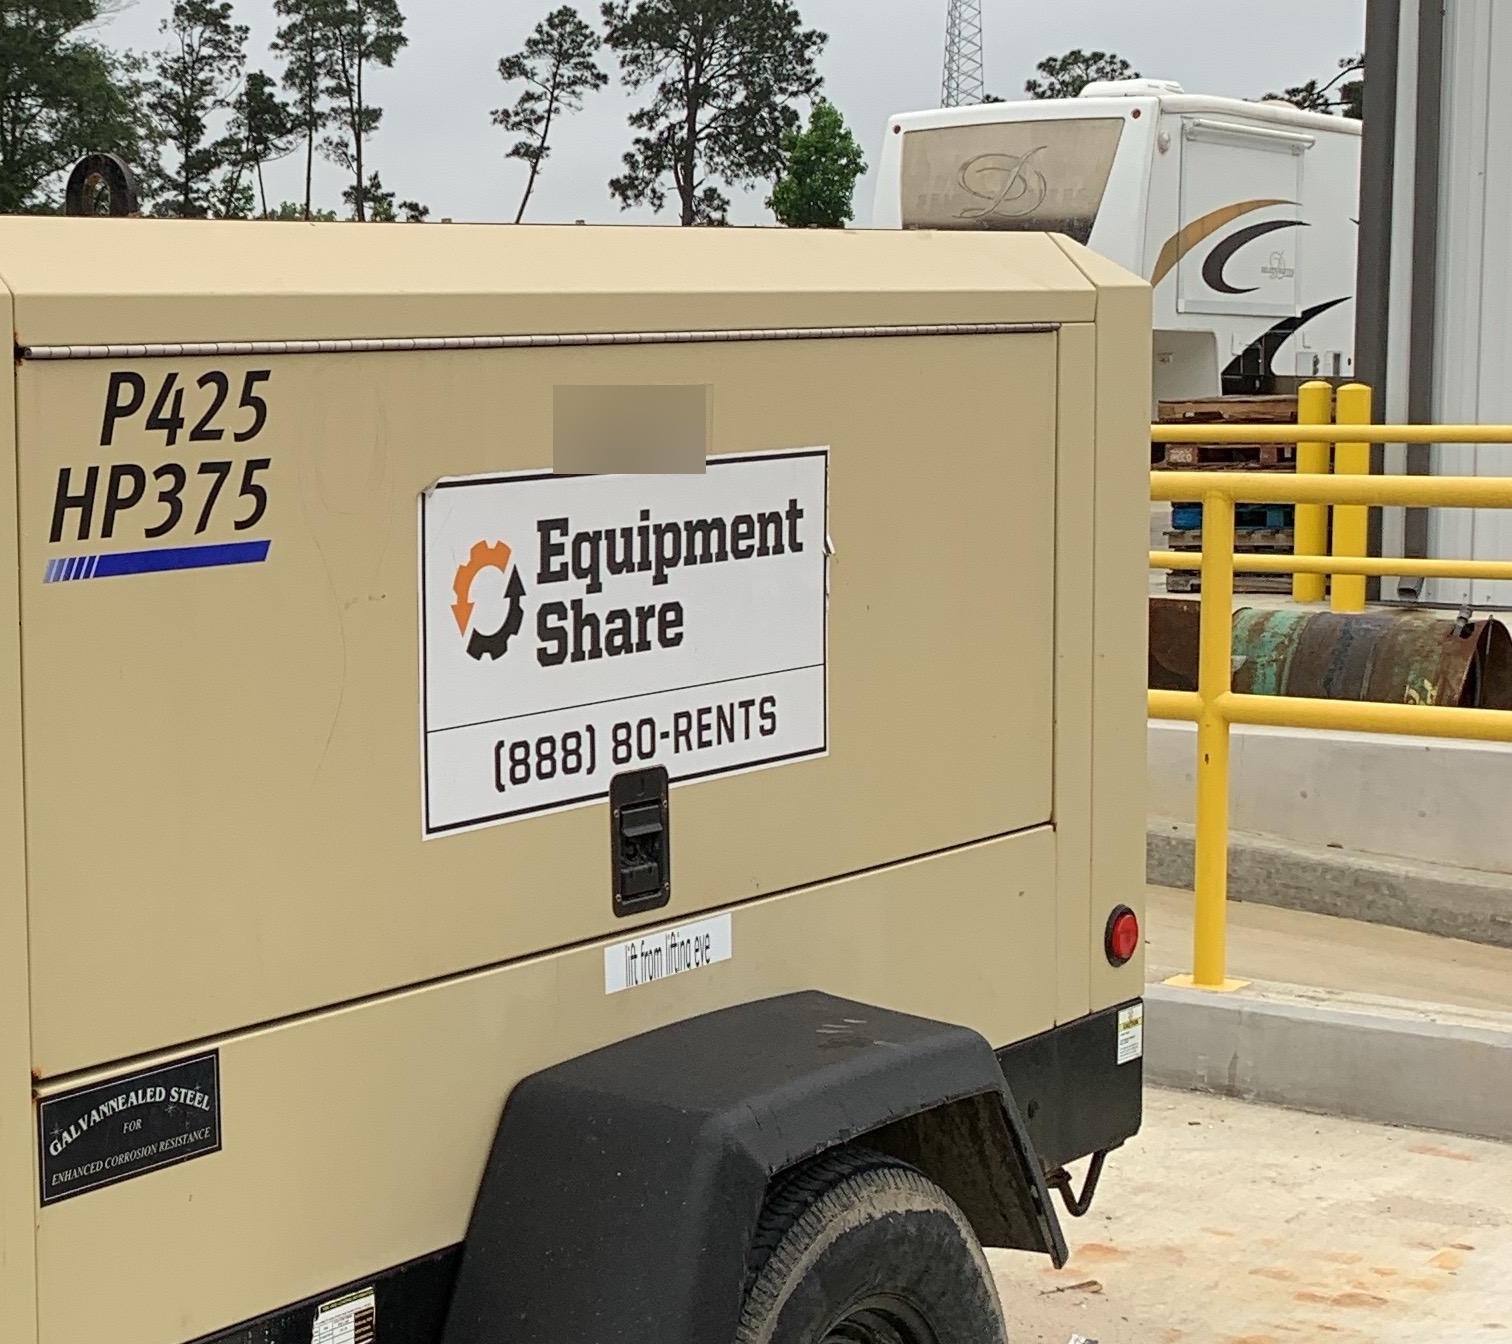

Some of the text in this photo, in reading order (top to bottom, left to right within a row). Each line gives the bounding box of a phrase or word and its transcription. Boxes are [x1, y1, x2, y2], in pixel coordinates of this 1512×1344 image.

[101, 369, 271, 446] P425
[50, 458, 271, 543] HP375
[536, 499, 804, 593] Equipment
[536, 600, 685, 667] Share
[494, 695, 778, 793] (888) 80-RENTS
[625, 942, 638, 987] lift
[641, 940, 662, 982] from
[49, 1086, 211, 1156] GALVANNEALED STEEL
[123, 1119, 142, 1134] FOR
[51, 1127, 211, 1186] ENHANCED CORROSION RESISTANCE
